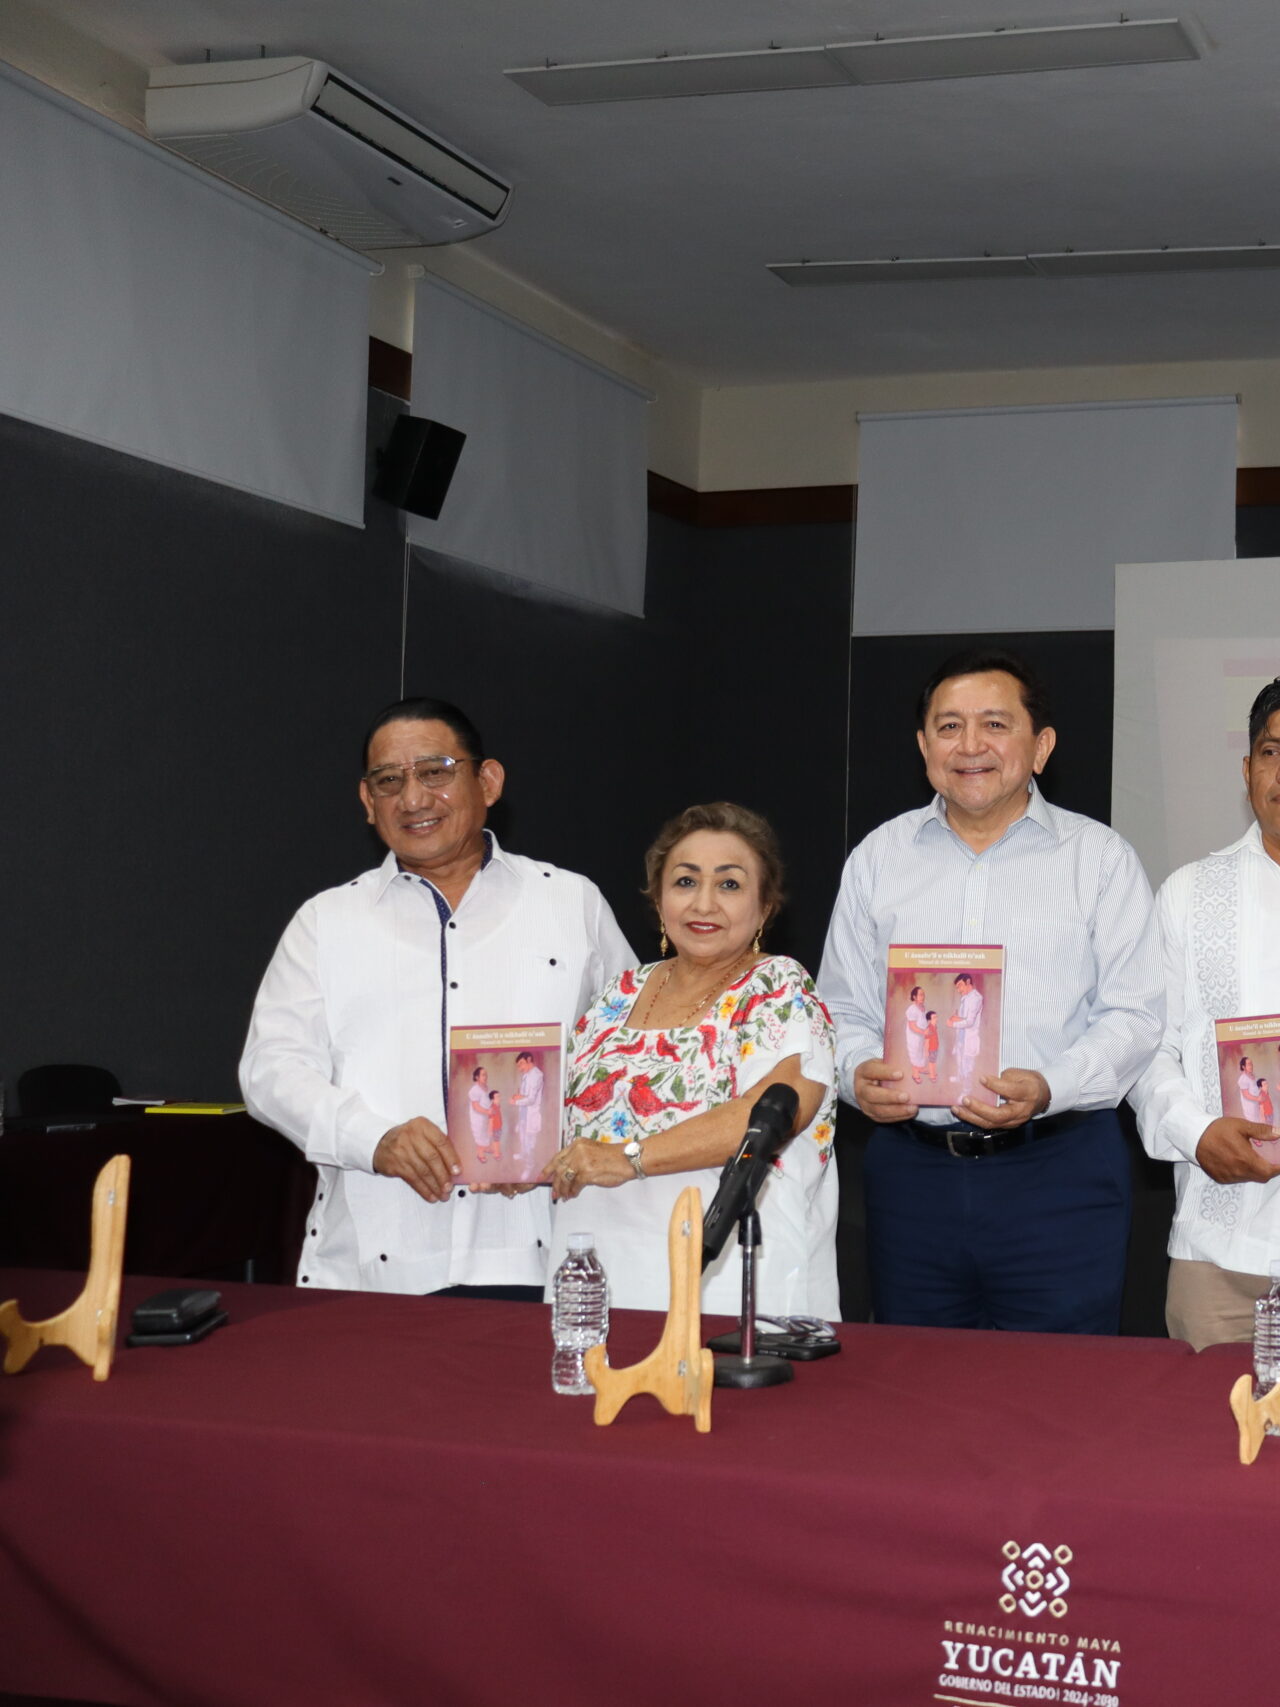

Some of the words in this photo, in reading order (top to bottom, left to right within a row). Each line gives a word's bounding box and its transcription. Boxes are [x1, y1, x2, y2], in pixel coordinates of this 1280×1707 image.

[944, 1620, 1069, 1646] RENACIMIENTO
[1076, 1636, 1121, 1653] MAYA
[941, 1640, 1121, 1689] YUCATÁN
[938, 1673, 992, 1692] GOBIERNO
[994, 1680, 1012, 1696] DEL
